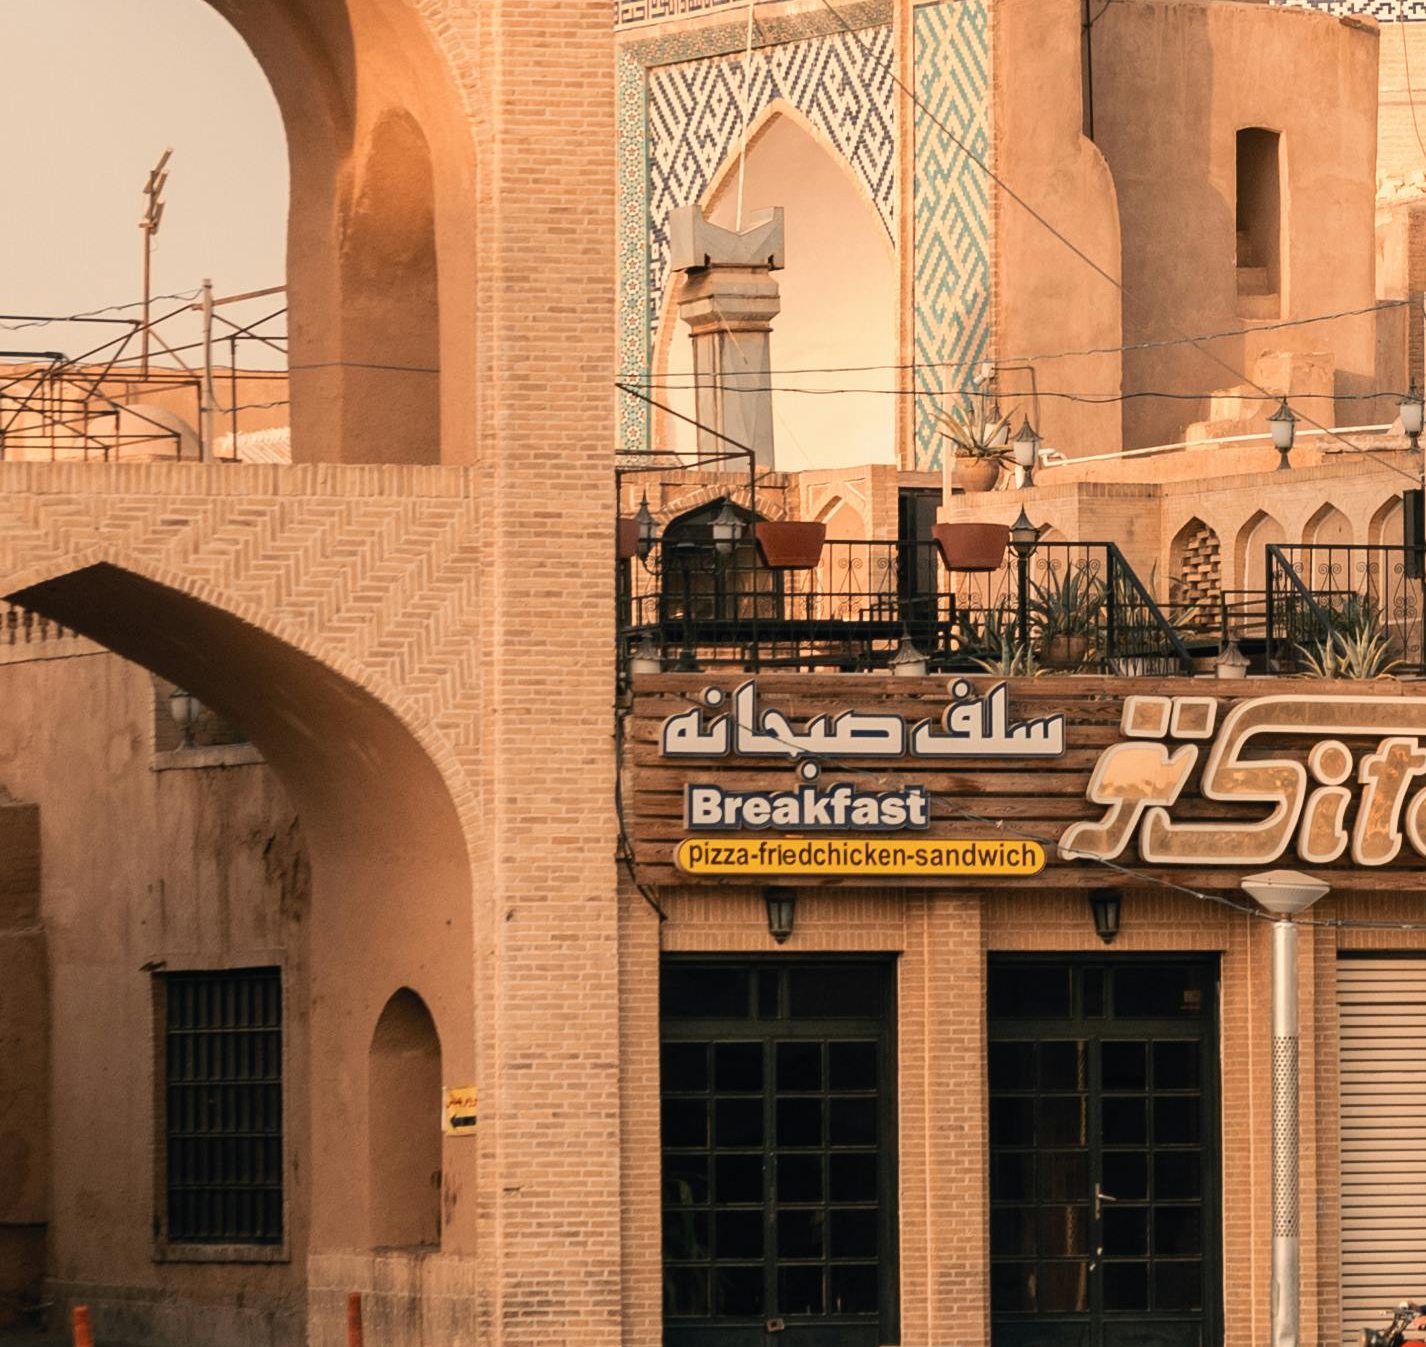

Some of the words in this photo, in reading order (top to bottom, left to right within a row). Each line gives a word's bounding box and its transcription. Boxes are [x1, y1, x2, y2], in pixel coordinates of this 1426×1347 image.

[660, 679, 906, 784] صبحانه
[909, 678, 1066, 755] سلف
[690, 786, 928, 828] Breakfast
[688, 841, 1036, 868] pizza-friedchicken-sandwich
